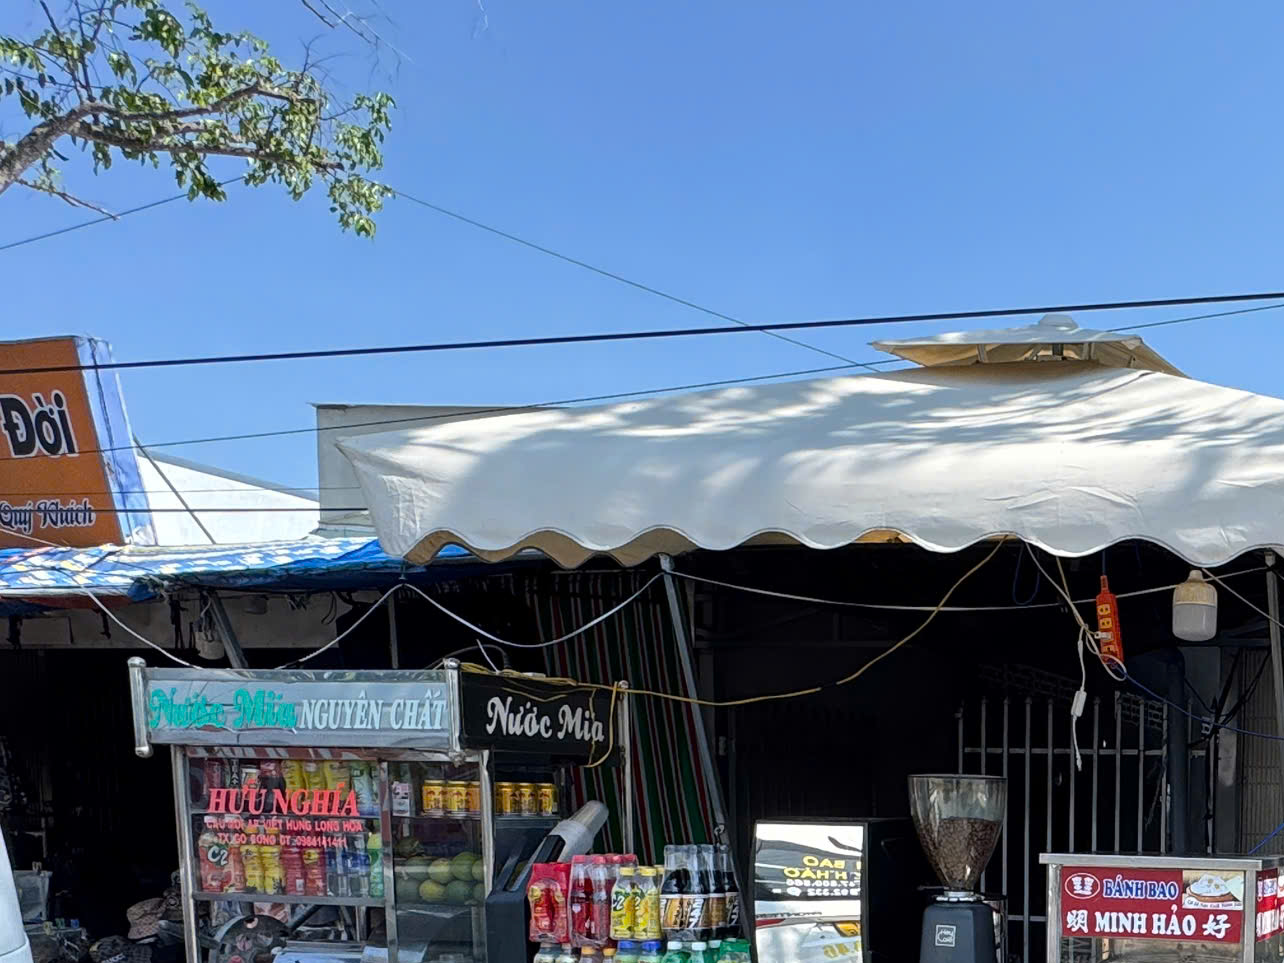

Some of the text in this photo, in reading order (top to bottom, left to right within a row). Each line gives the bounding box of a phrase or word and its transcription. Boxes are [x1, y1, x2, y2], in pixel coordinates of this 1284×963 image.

[0, 390, 79, 457] Đời
[36, 498, 96, 529] Khách
[300, 689, 383, 730] NGUYÊN
[389, 689, 446, 730] CHẤT
[486, 696, 553, 739] Nước
[314, 820, 340, 832] LONG
[207, 845, 229, 866] C2
[1102, 874, 1179, 900] BÁNH BAO
[1094, 903, 1197, 937] MINH HẢO
[1202, 914, 1231, 939] 好
